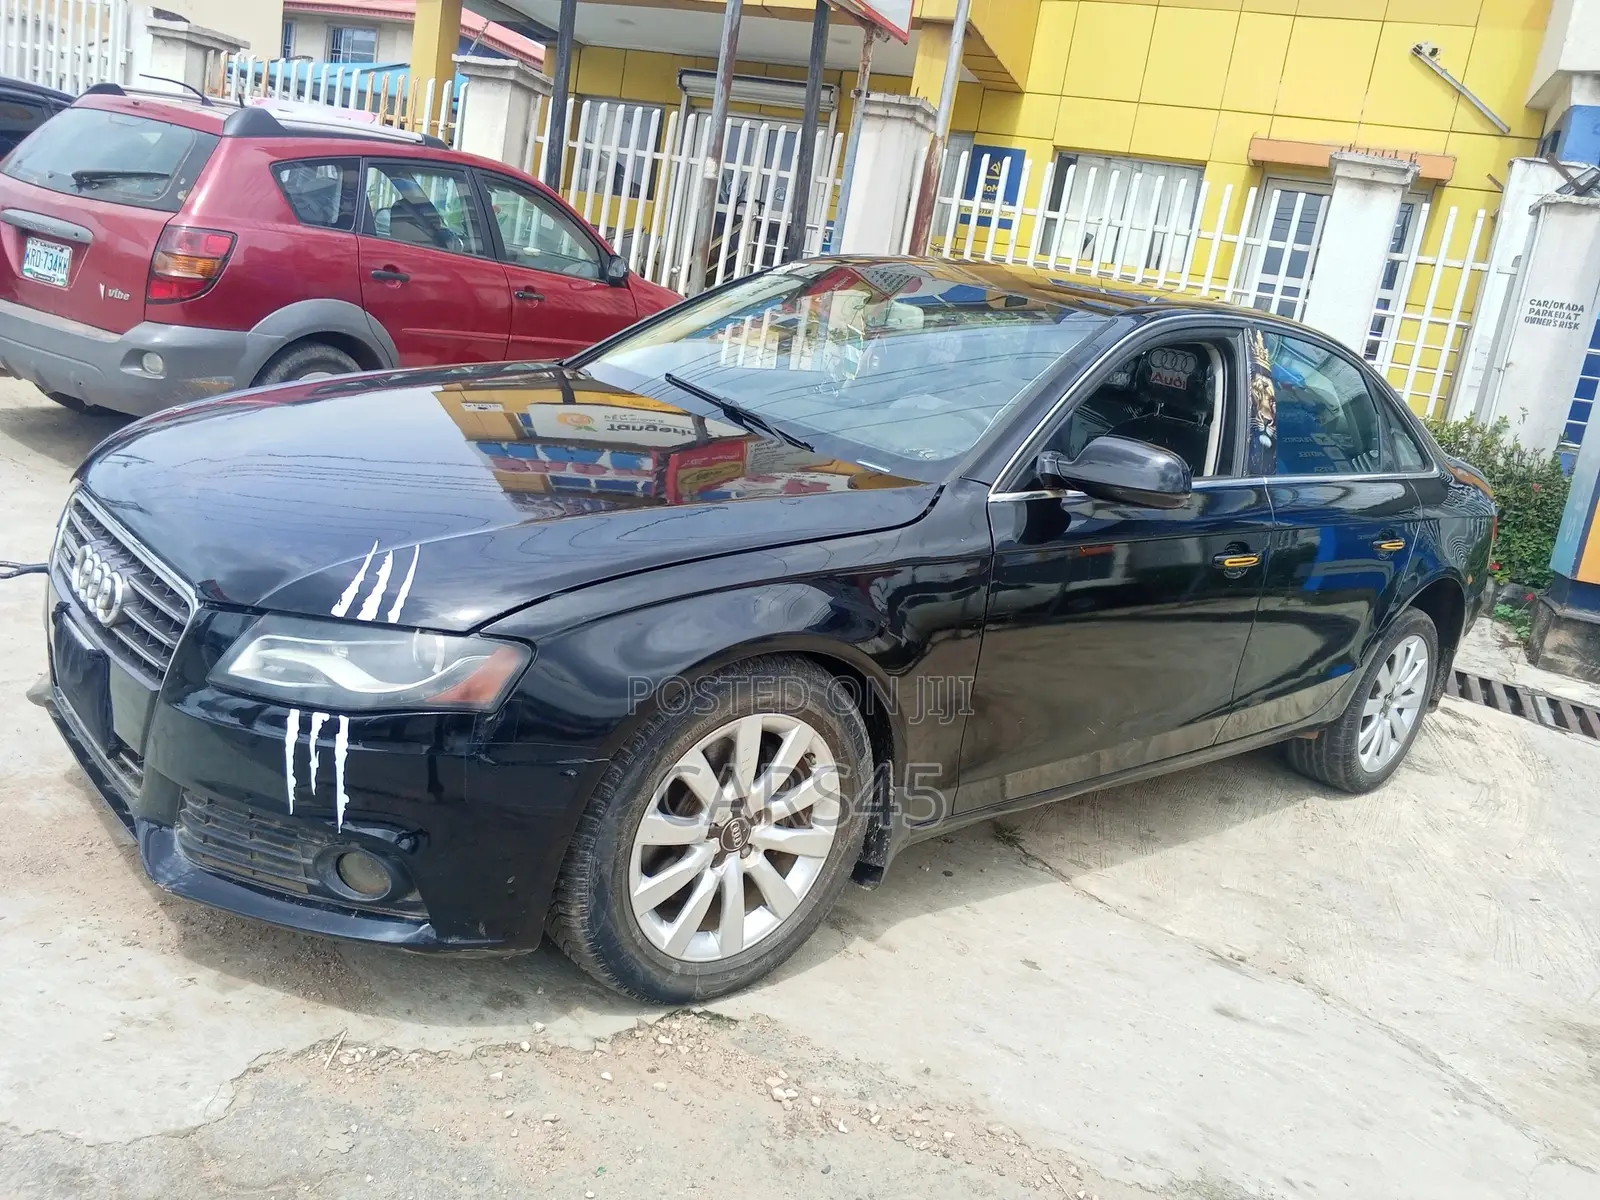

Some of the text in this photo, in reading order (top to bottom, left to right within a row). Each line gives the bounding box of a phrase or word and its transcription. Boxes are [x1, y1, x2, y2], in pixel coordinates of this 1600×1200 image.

[108, 288, 130, 300] vibe
[1529, 298, 1585, 313] CAR/OKADA
[1558, 320, 1580, 331] RISK
[1151, 371, 1187, 389] Audi
